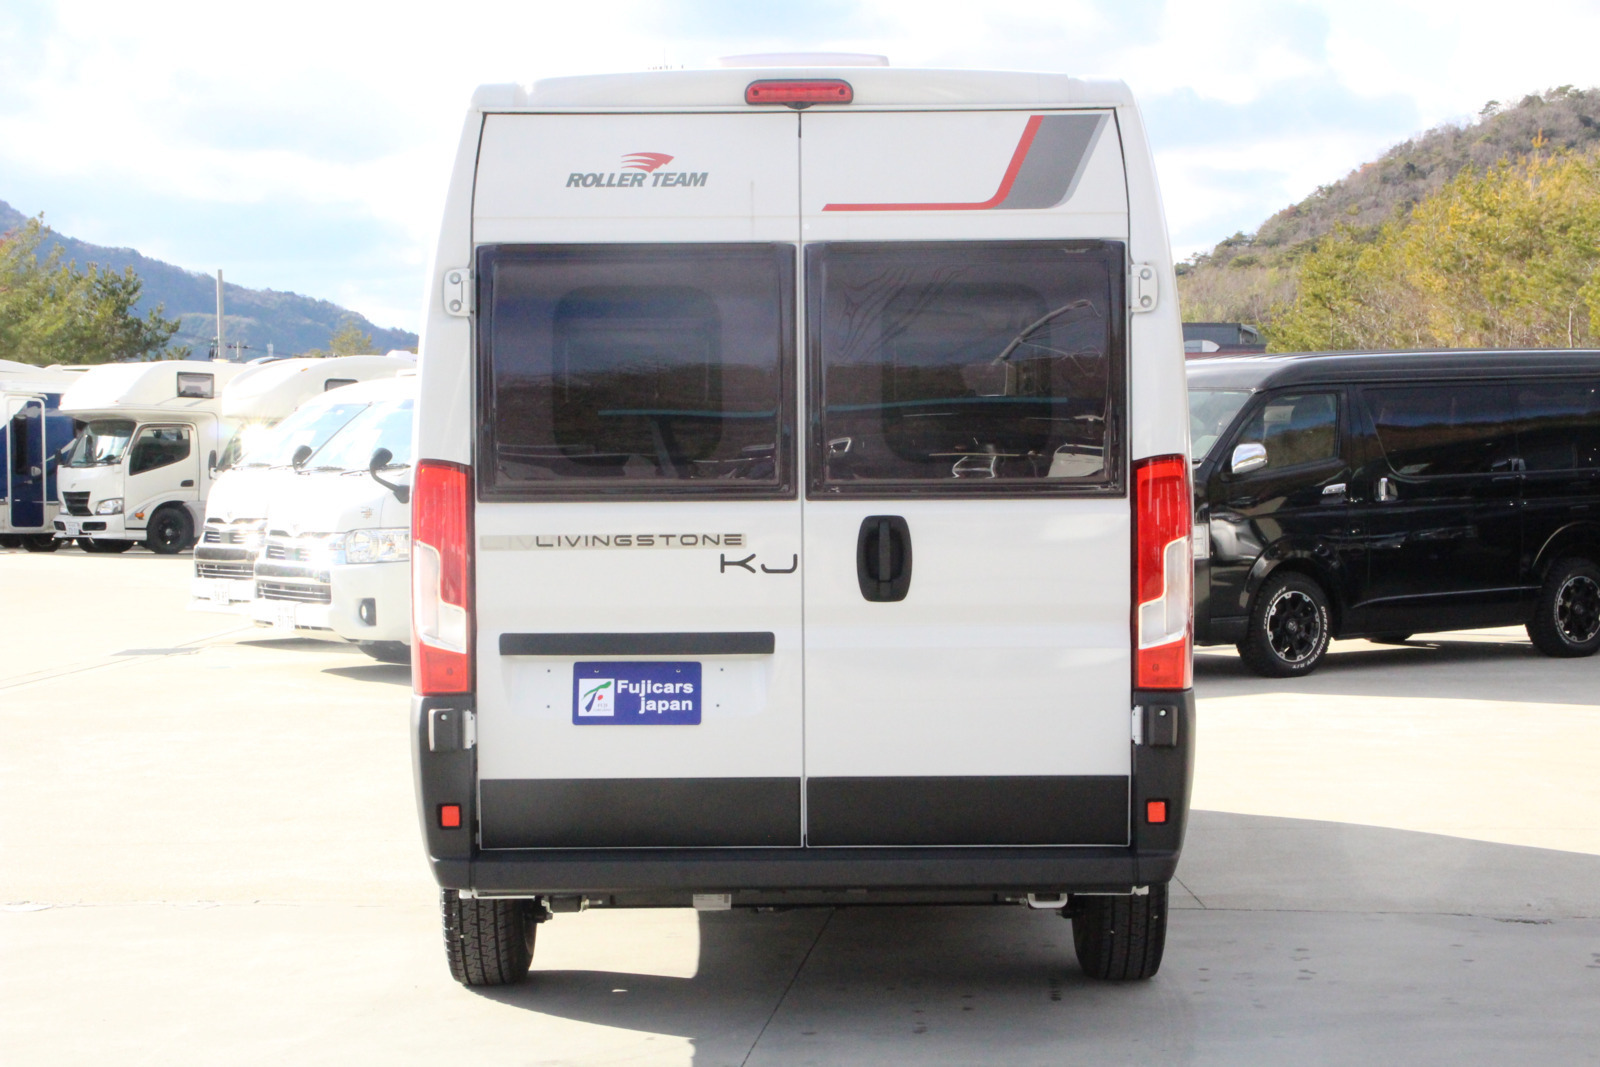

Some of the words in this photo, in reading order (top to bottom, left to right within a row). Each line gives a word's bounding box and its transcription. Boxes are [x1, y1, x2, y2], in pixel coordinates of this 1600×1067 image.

[565, 173, 647, 188] ROLLER
[652, 172, 709, 187] TEAM
[536, 533, 743, 548] LIVINGSTONE
[720, 553, 798, 574] KJ
[1320, 606, 1328, 631] OPEN
[617, 680, 694, 697] Fujicars
[638, 697, 693, 714] japan
